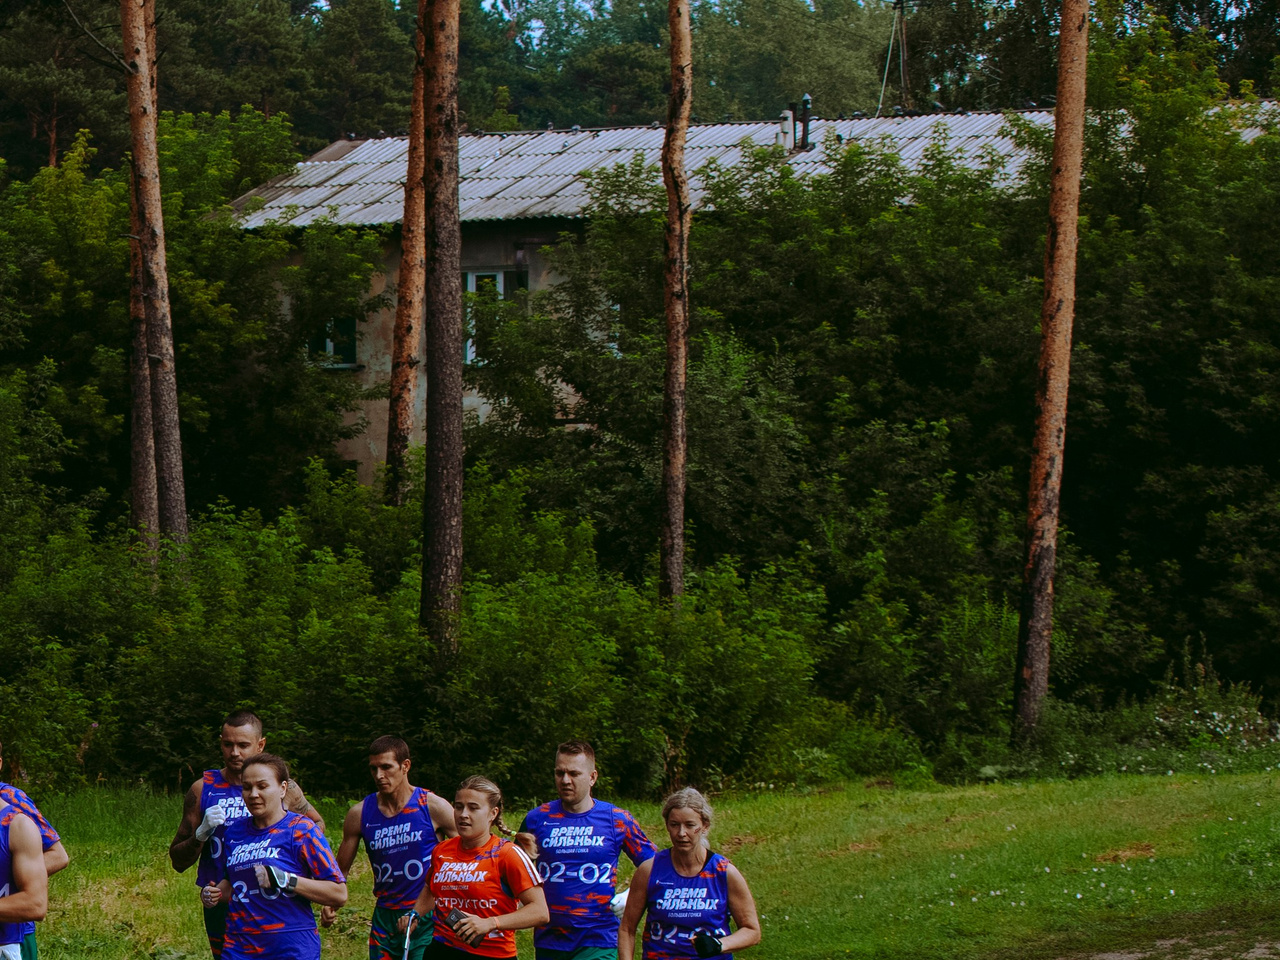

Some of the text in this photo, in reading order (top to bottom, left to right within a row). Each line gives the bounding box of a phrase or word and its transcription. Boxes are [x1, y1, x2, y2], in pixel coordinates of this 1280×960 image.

[375, 822, 411, 840] ВРЕМЯ
[550, 826, 594, 838] ВРЕМЯ
[370, 830, 423, 850] СИЛЬНЫХ
[542, 835, 605, 848] СИЛЬНЫХ
[226, 847, 281, 867] СИЛЬНЫХ
[439, 861, 479, 872] ВРЕМЯ
[538, 861, 612, 885] 02-02
[433, 870, 488, 883] СИЛЬНЫХ
[663, 888, 708, 899] ВРЕМЯ
[656, 898, 719, 910] СИЛЬНЫХ
